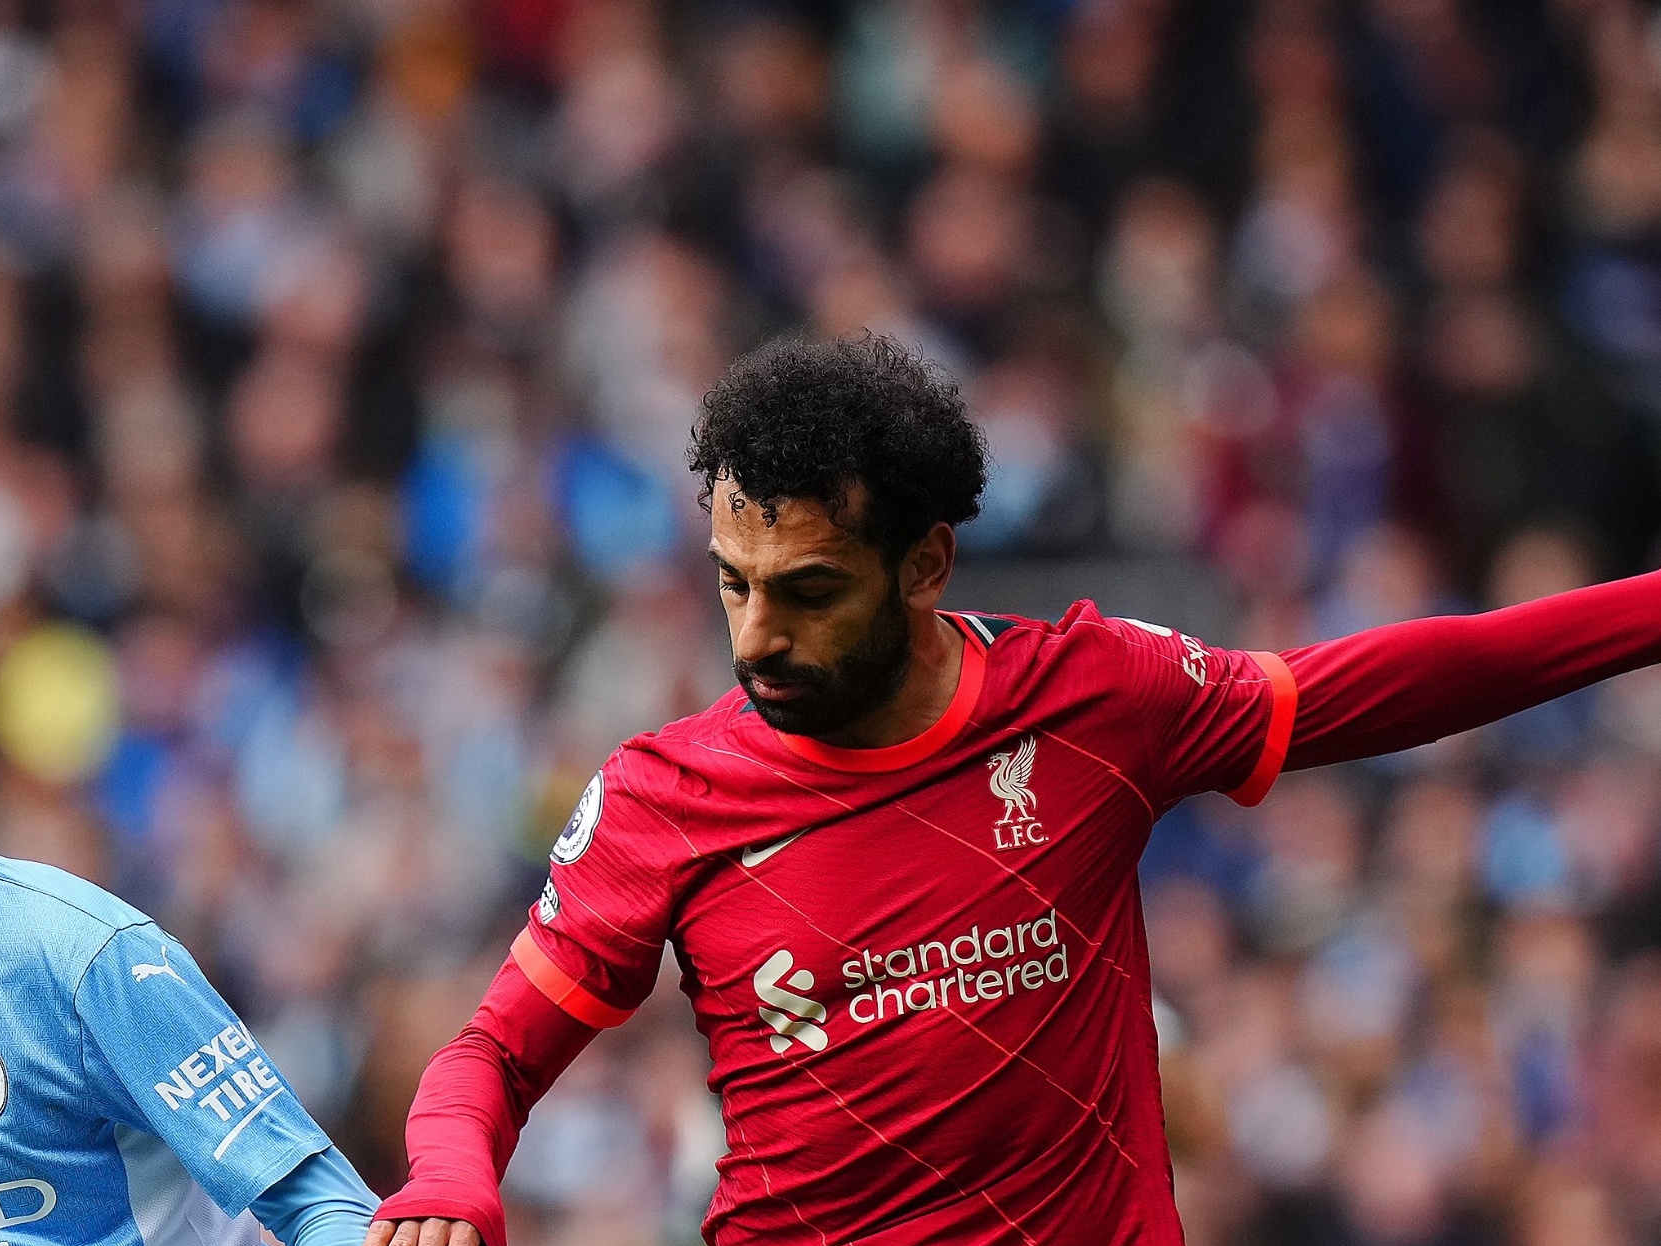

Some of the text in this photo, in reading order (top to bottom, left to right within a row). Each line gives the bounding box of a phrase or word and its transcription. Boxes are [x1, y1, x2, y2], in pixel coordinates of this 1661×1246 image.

[993, 822, 1050, 850] L.F.C.
[841, 907, 1059, 990] standard
[848, 942, 1069, 1024] chartered
[197, 1056, 280, 1122] TIRE
